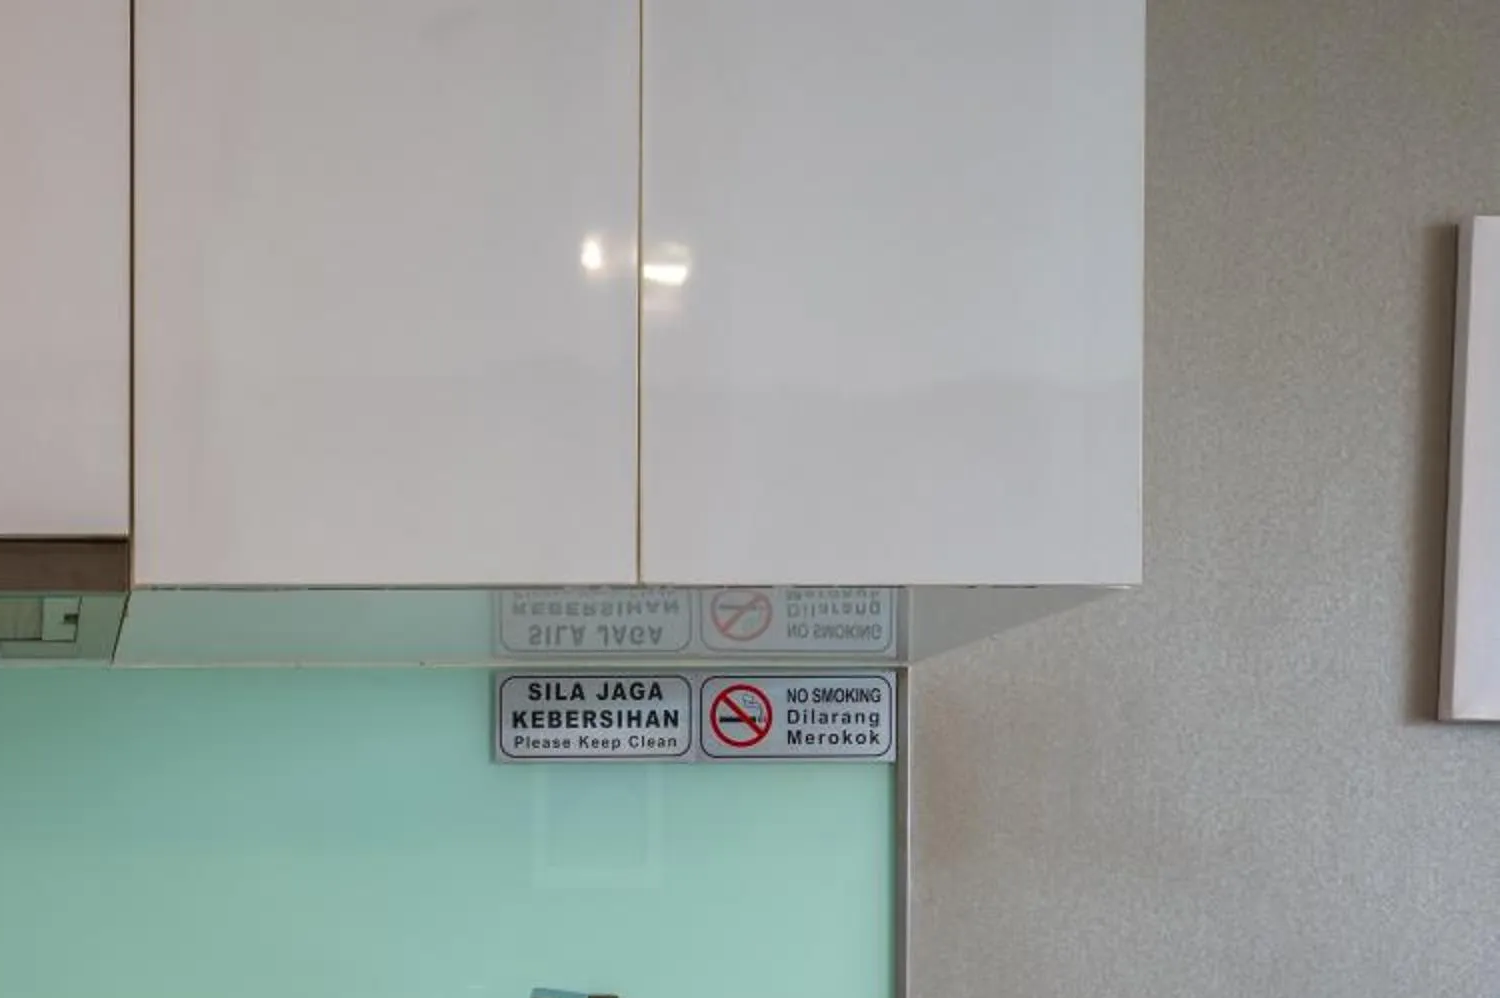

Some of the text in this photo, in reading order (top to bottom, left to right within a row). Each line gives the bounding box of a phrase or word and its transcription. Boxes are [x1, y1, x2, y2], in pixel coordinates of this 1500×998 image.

[528, 682, 663, 701] SILA JAGA
[787, 688, 881, 703] NO SMOKING
[512, 709, 679, 729] KEBERSIHAN
[787, 709, 880, 728] Dilarang
[514, 736, 677, 750] Please Keep Clean
[787, 730, 881, 745] Merokok
